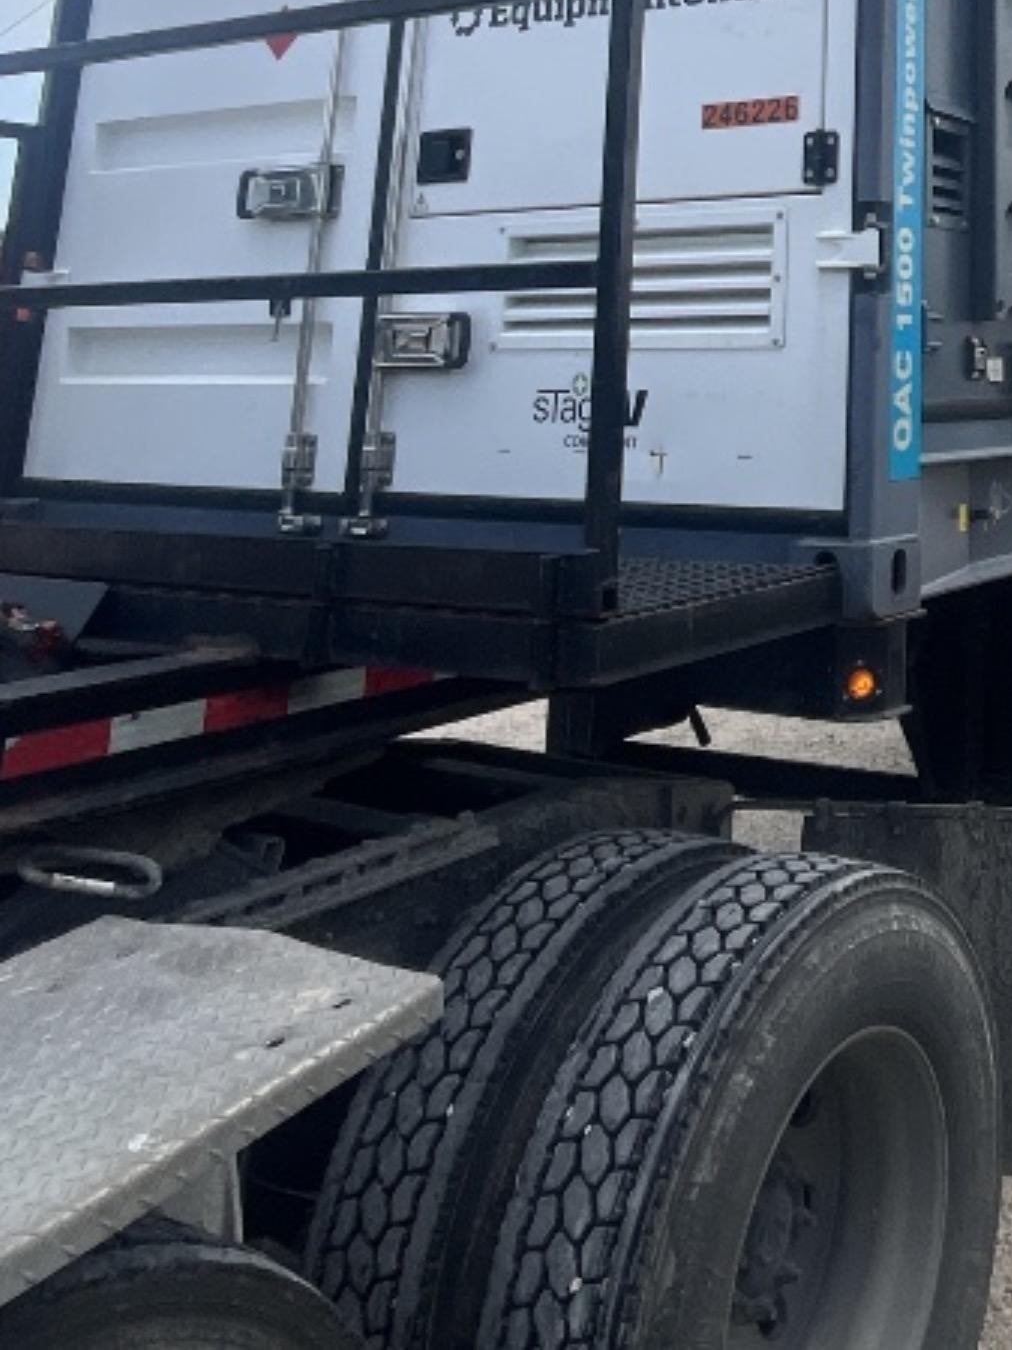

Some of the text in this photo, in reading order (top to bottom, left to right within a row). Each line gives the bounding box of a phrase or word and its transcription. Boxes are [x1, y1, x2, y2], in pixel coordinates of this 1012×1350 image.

[703, 97, 798, 128] 246226
[896, 226, 914, 331] 1500
[893, 349, 913, 452] QAC
